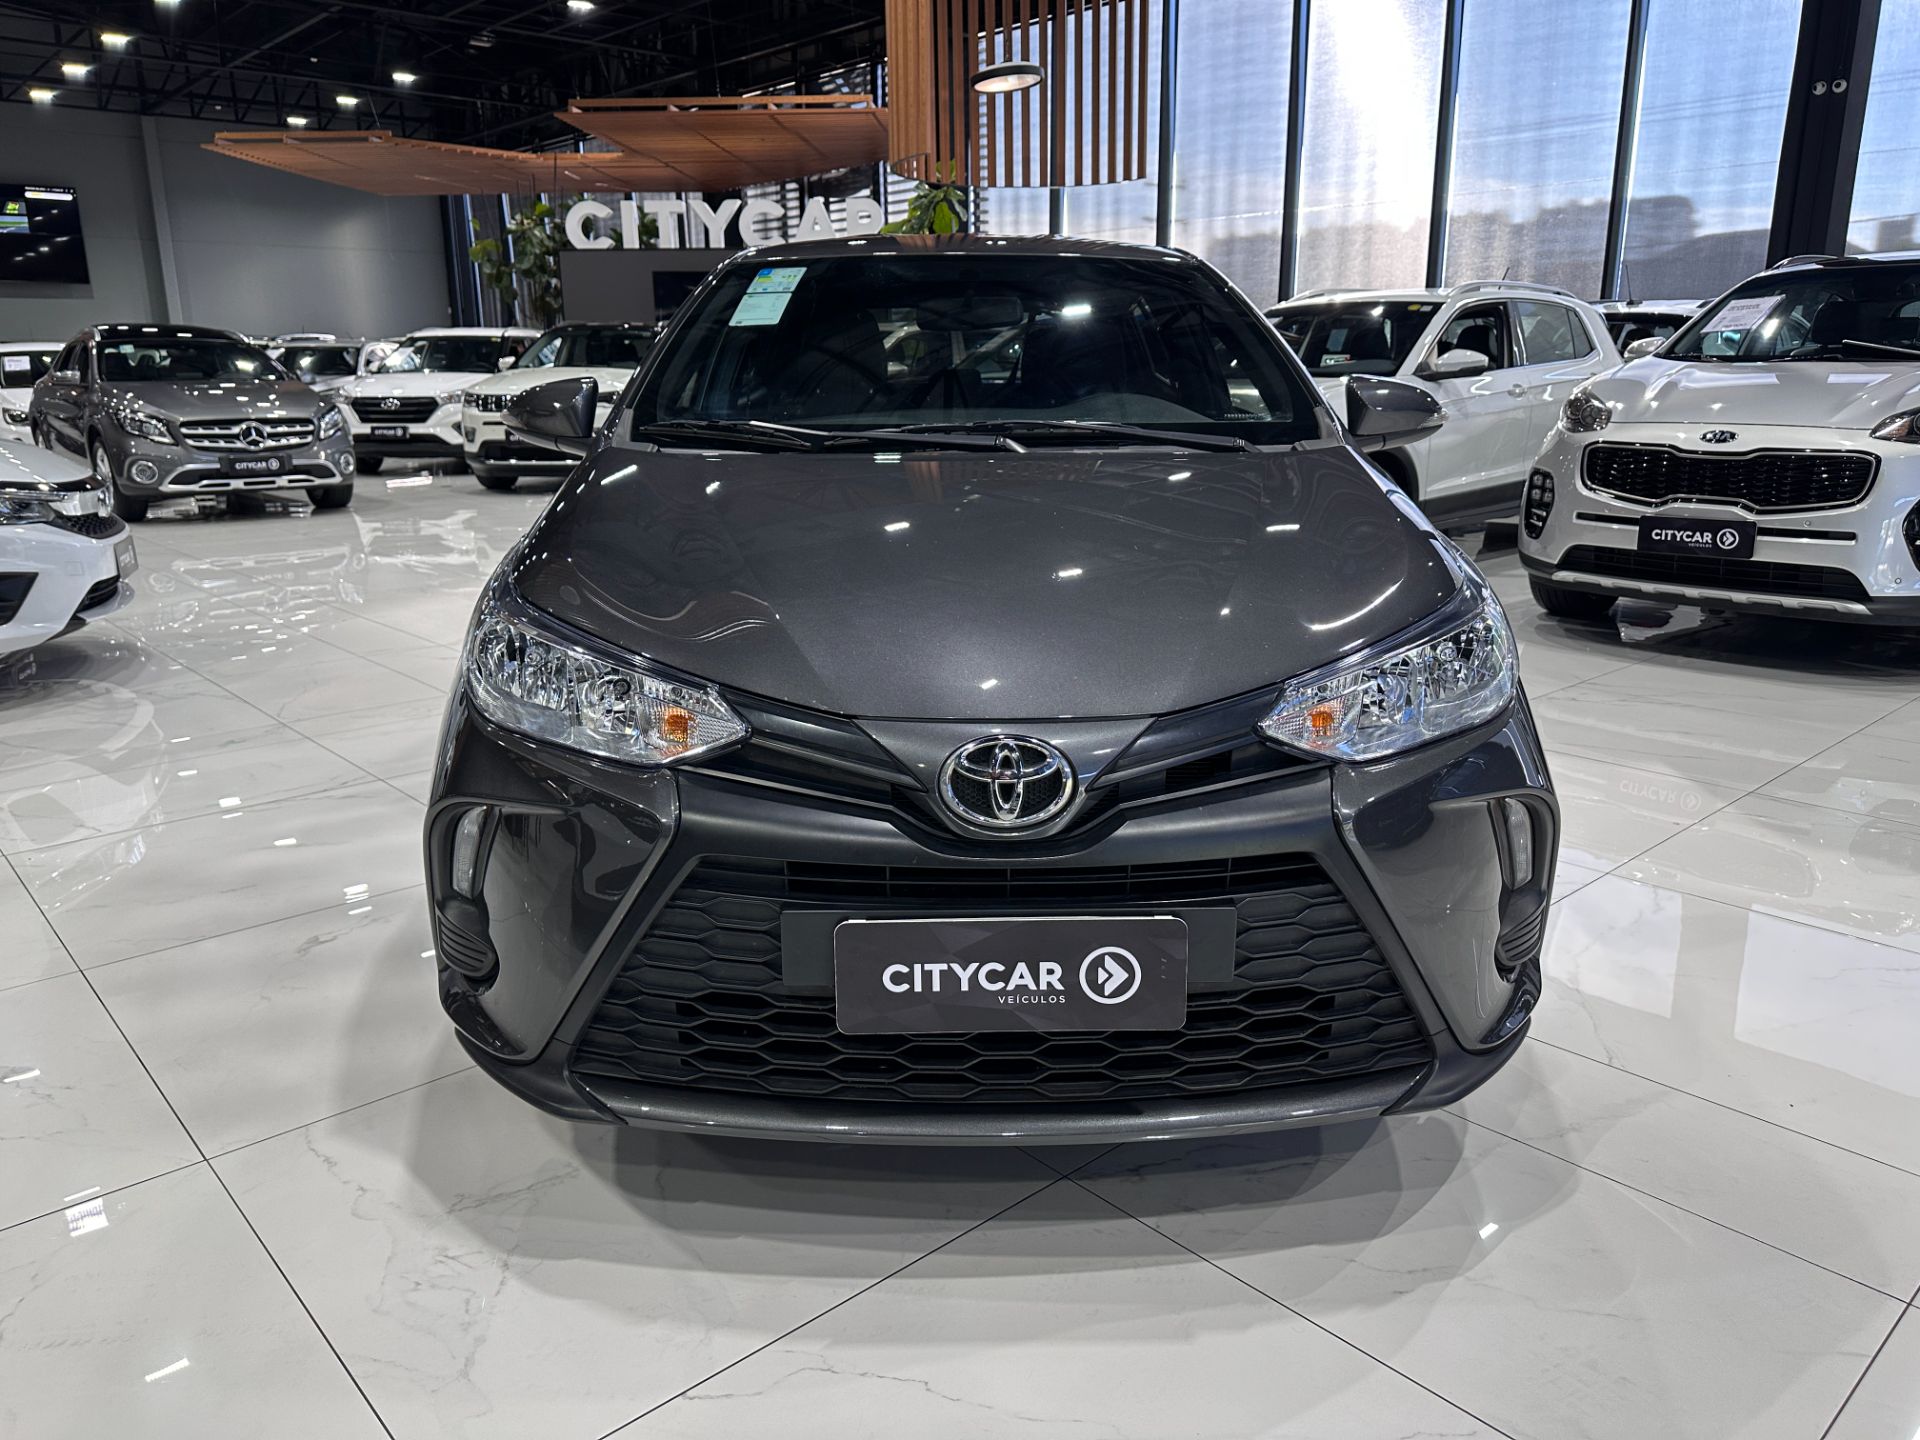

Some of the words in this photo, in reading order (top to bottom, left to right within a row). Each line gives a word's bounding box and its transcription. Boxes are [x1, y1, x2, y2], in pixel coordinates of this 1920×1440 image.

[565, 196, 885, 250] CITYCAR
[235, 461, 267, 470] CITYCAR
[1651, 529, 1712, 543] CITYCAR
[882, 961, 1065, 993] CITYCAR
[998, 994, 1066, 1004] VEÍCULOS
